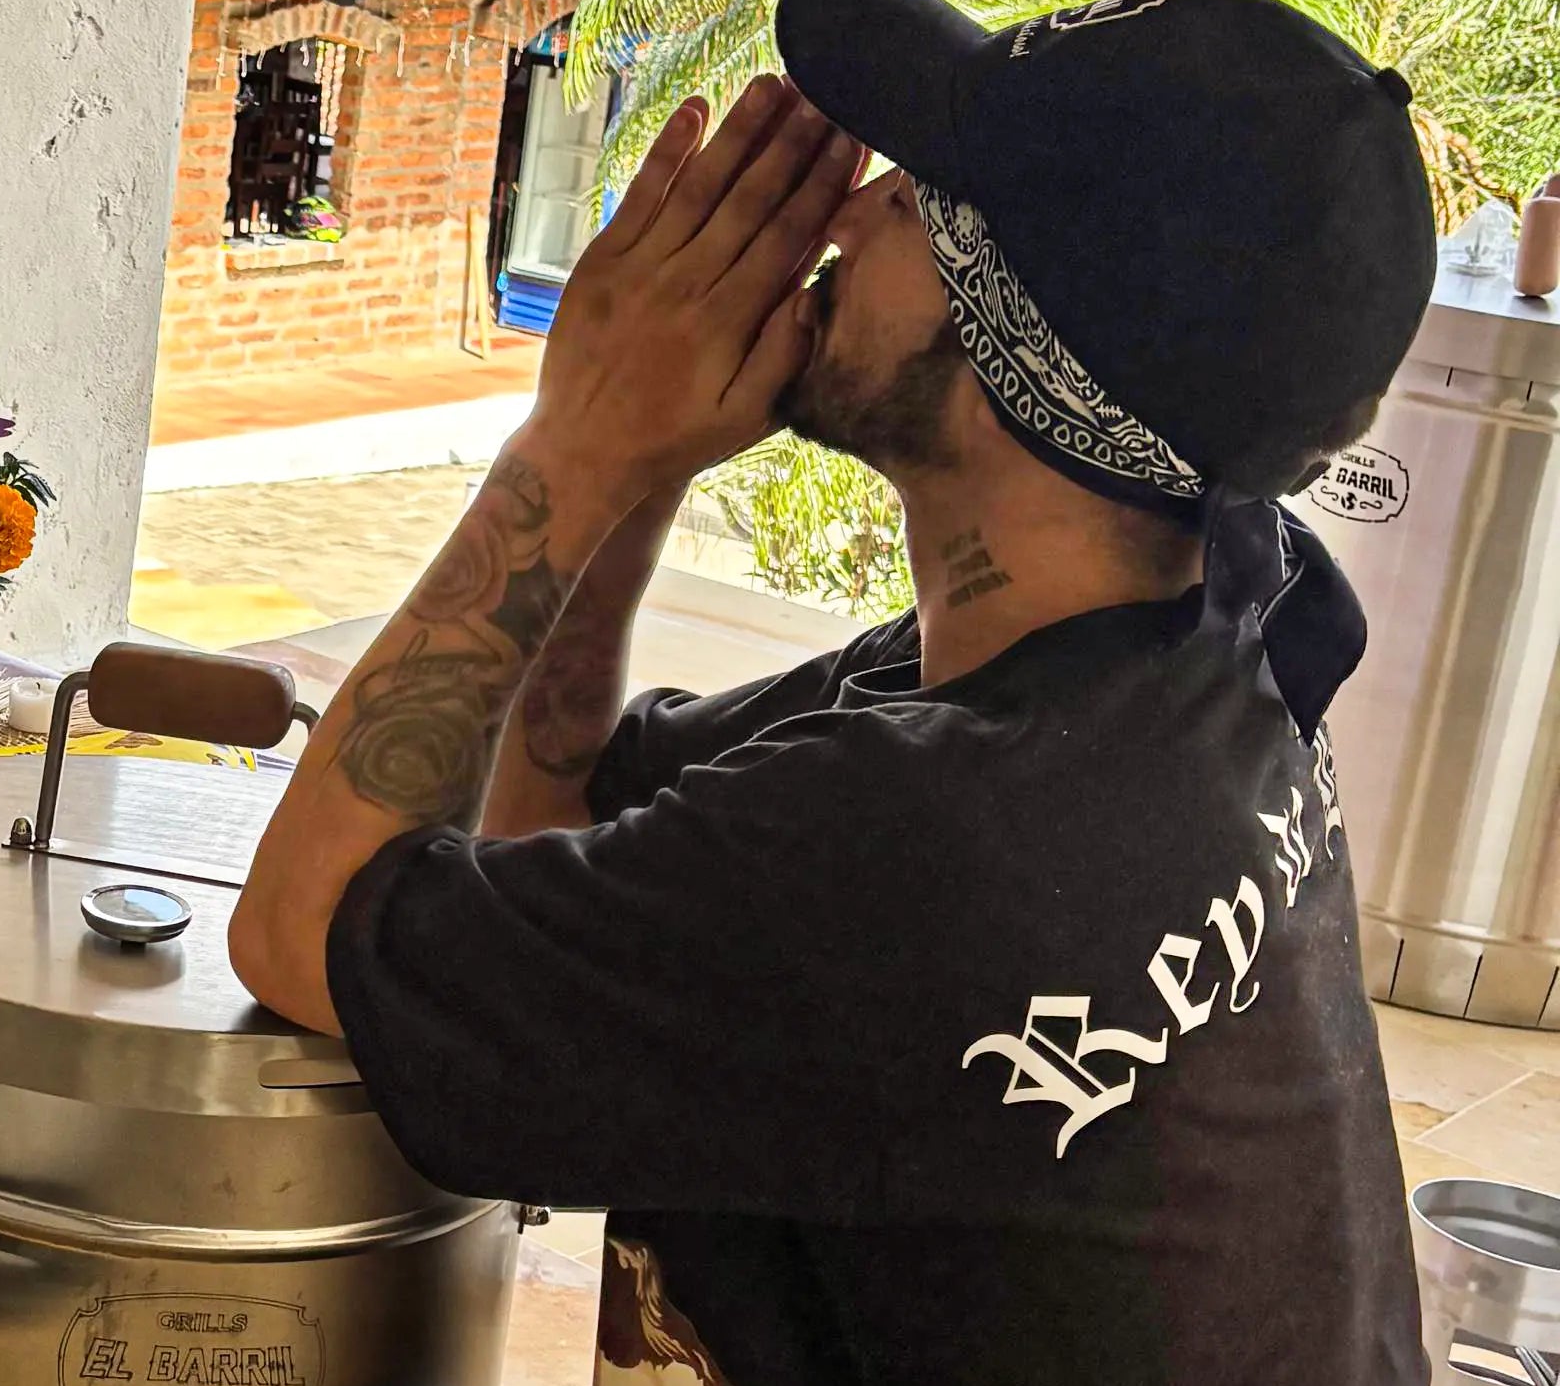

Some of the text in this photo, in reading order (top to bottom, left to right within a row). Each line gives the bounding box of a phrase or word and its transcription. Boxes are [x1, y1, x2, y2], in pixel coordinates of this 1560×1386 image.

[1336, 468, 1398, 501] BARRIL
[156, 1310, 248, 1333] GRILLS
[80, 1337, 134, 1382] EL
